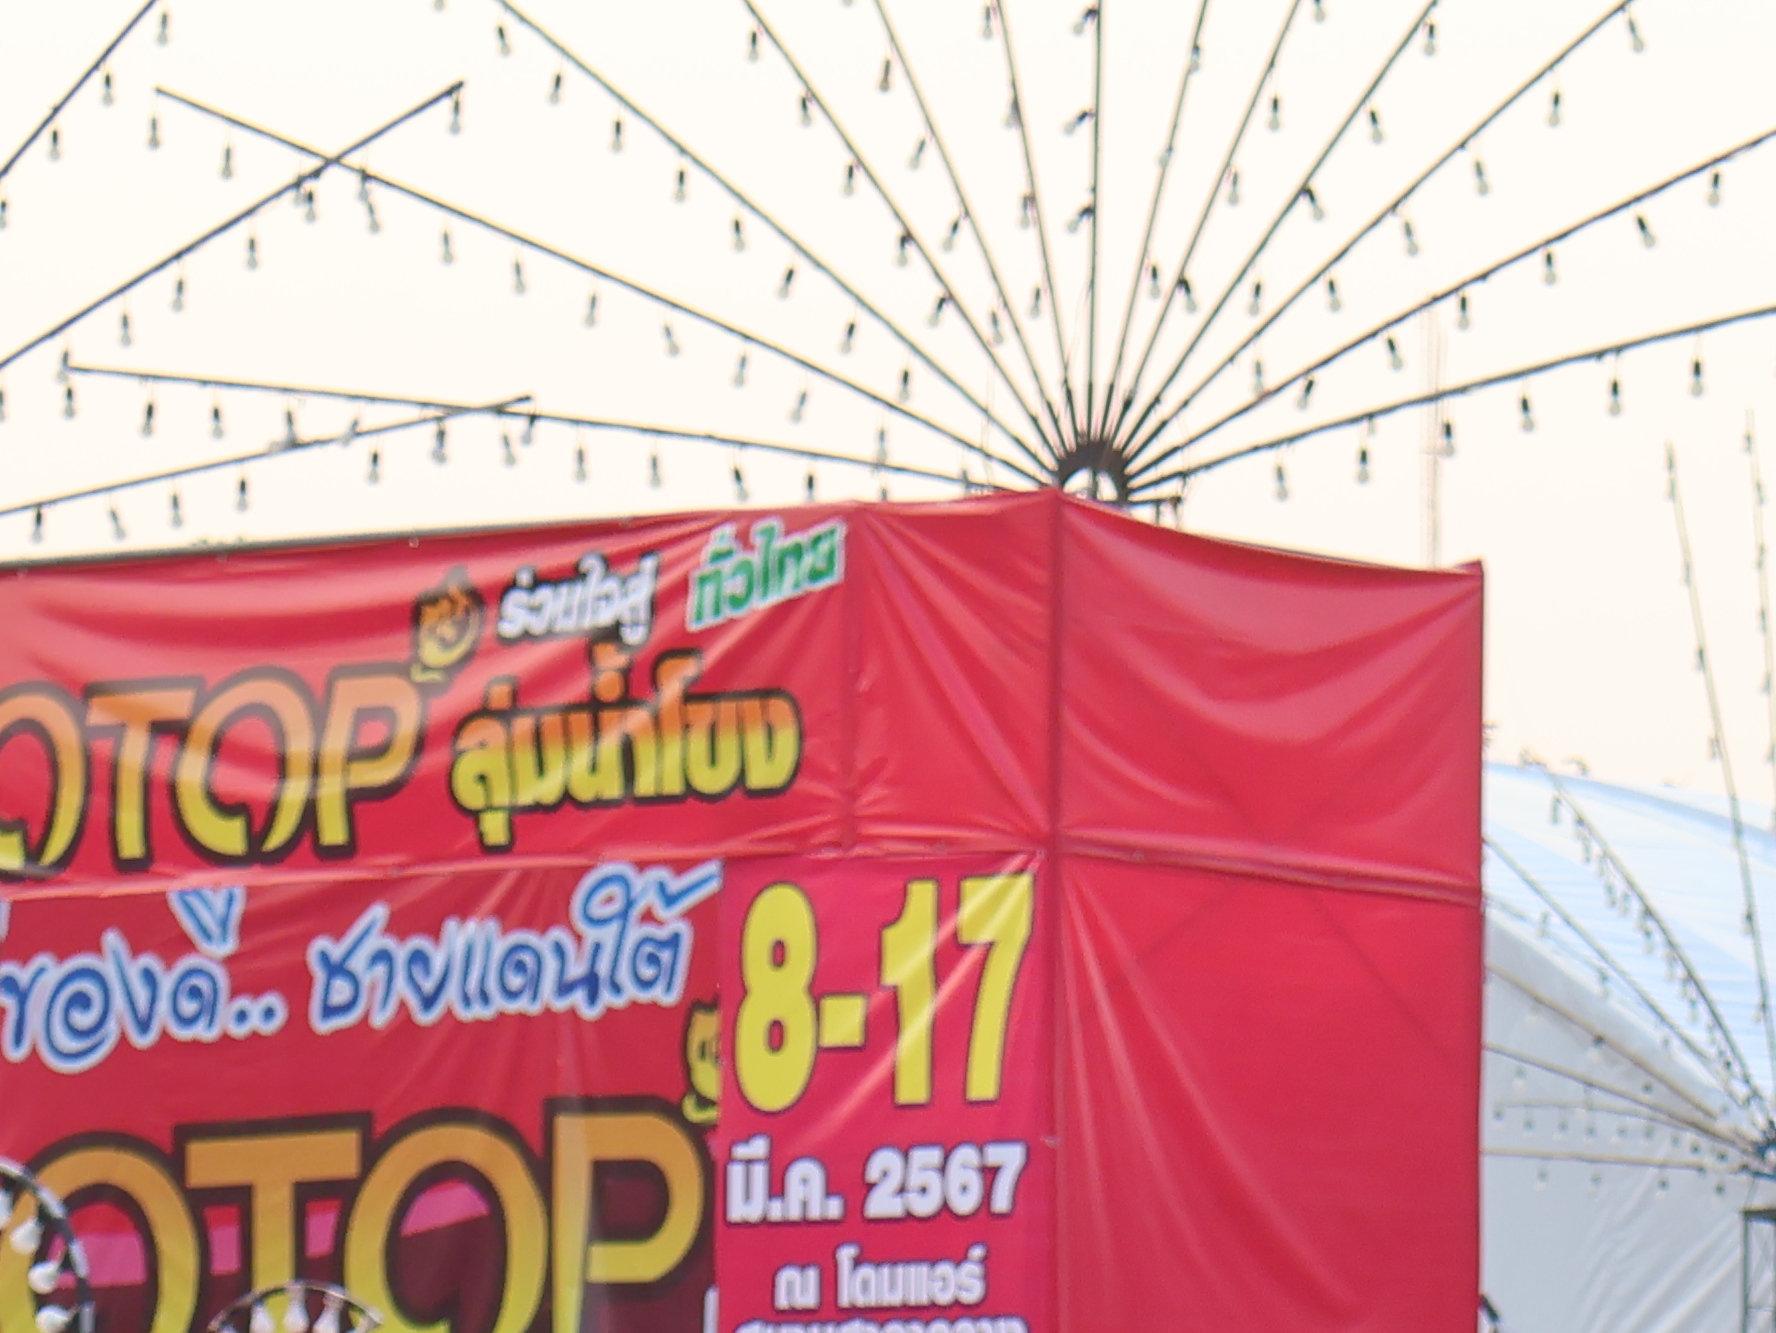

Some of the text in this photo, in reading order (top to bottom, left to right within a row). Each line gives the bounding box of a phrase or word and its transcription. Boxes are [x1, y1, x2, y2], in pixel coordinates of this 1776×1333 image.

[0, 666, 425, 877] OTOP
[308, 860, 723, 1036] ชายแดนใต้
[734, 872, 1034, 1112] 8-17
[726, 1133, 1029, 1224] มี.ค. 2567
[774, 1263, 821, 1310] ณ
